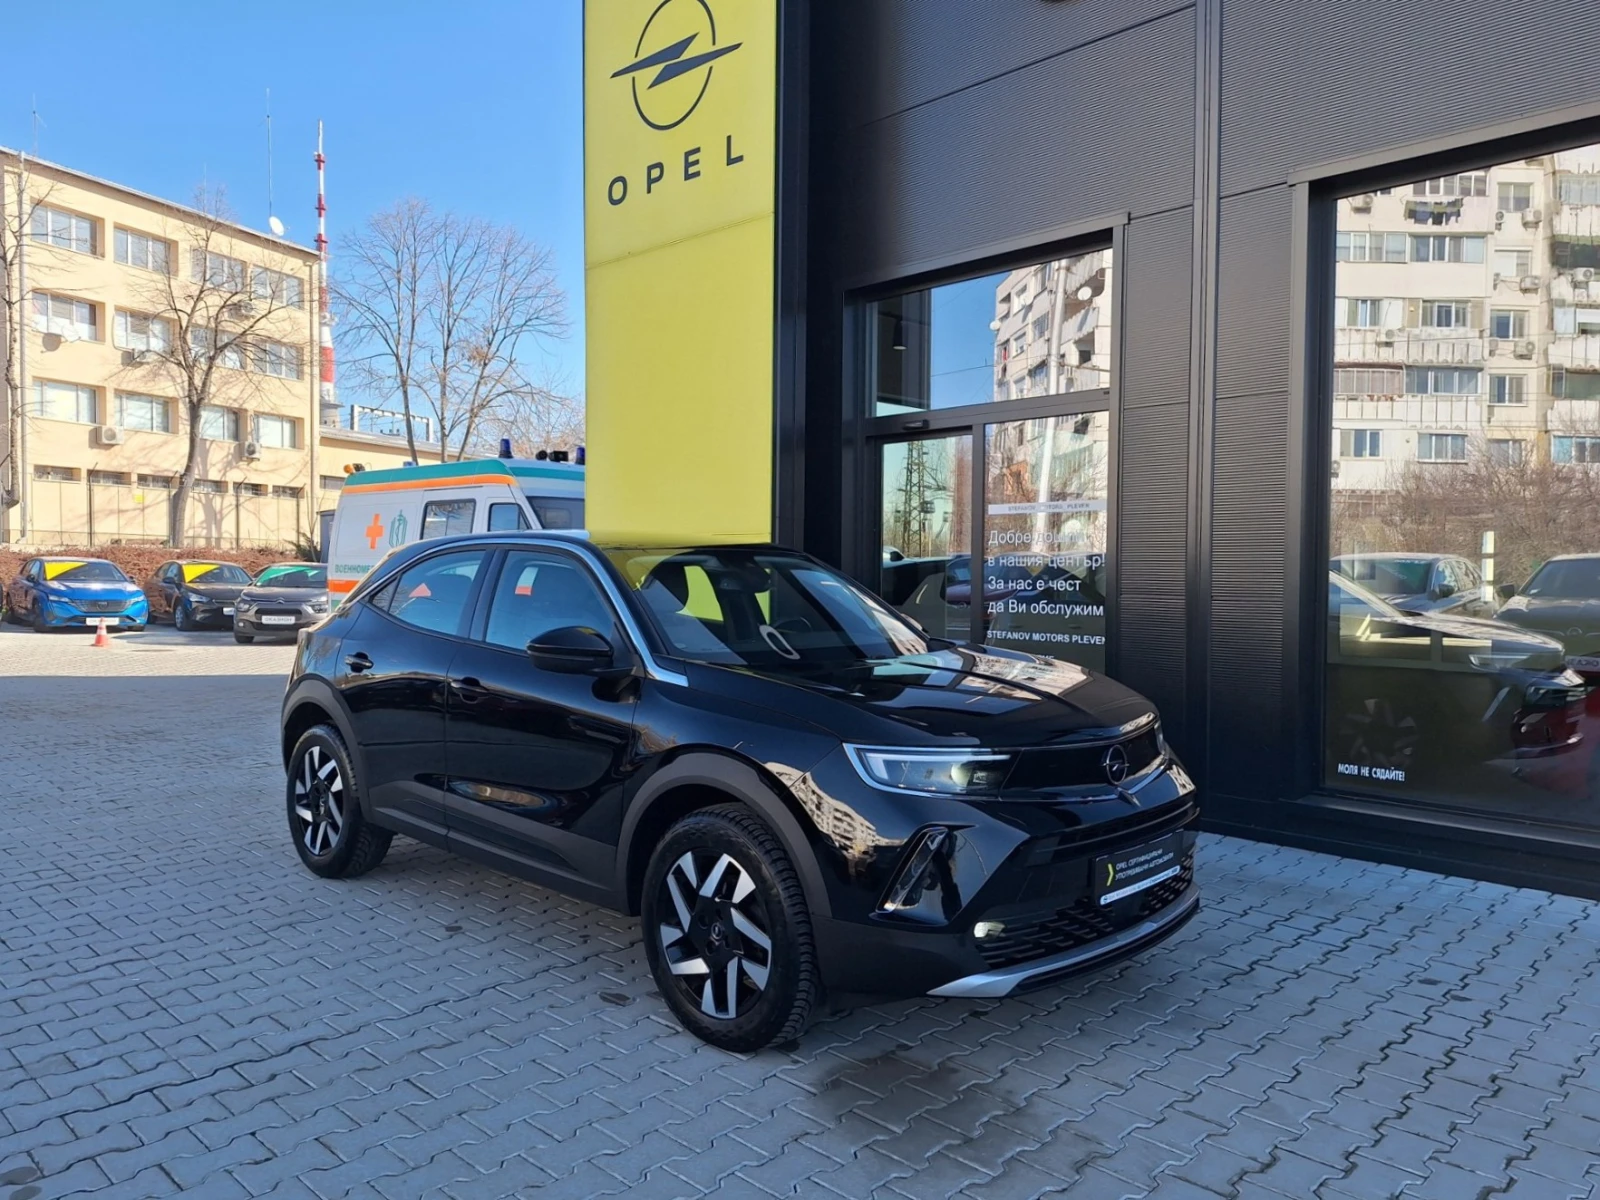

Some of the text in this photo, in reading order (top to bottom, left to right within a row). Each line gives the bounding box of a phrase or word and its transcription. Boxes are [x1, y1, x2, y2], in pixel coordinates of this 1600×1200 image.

[607, 134, 744, 206] OPEL
[988, 530, 1032, 546] Добре
[987, 553, 1106, 570] в нашия център!
[988, 576, 1082, 591] За нас е чест
[987, 599, 1104, 619] да Ви обслужим
[986, 630, 1031, 640] STEFANOV
[1032, 633, 1070, 643] MOTORS
[1338, 763, 1358, 775] МОЛЯ
[1361, 766, 1370, 777] НЕ
[1115, 861, 1128, 870] OPEL
